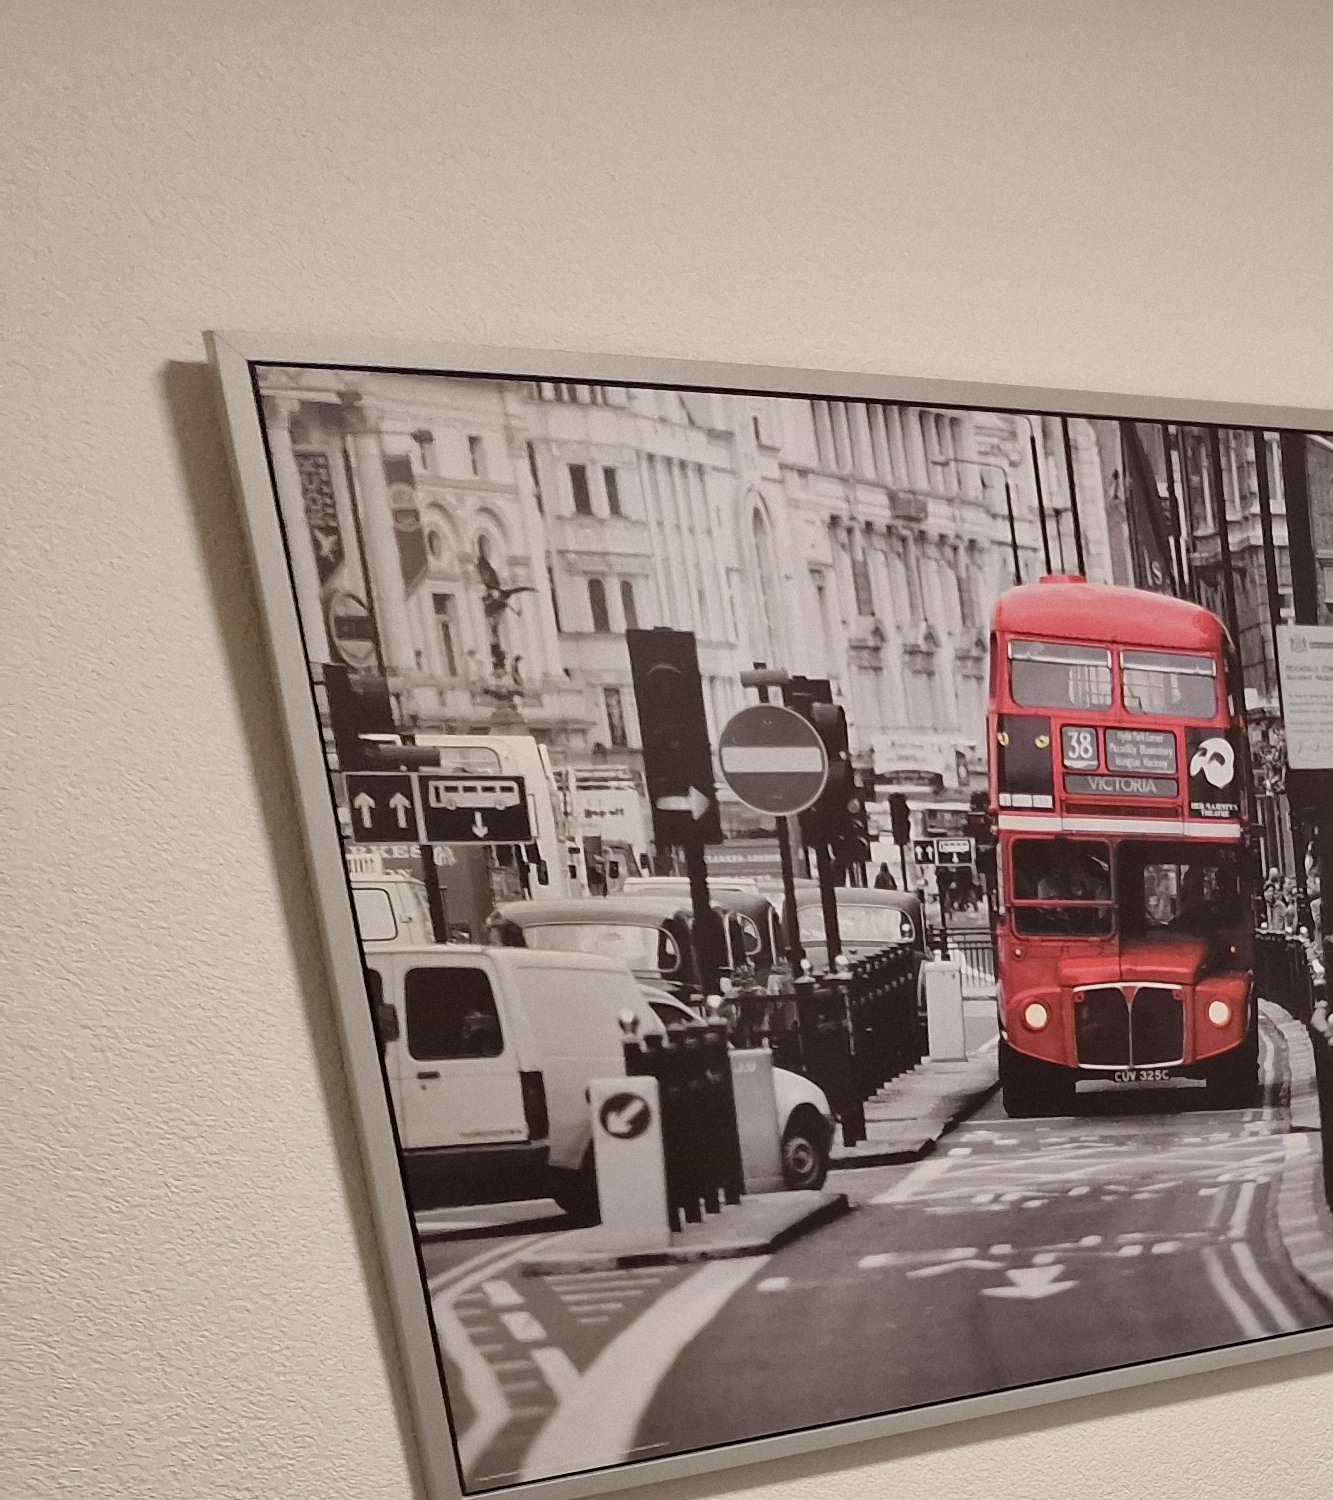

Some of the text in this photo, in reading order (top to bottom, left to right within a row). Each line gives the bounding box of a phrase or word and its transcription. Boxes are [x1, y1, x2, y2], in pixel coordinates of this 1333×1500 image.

[1068, 731, 1093, 759] 38
[1087, 777, 1156, 793] VICTORIA
[1114, 1069, 1170, 1082] CUV 325C
